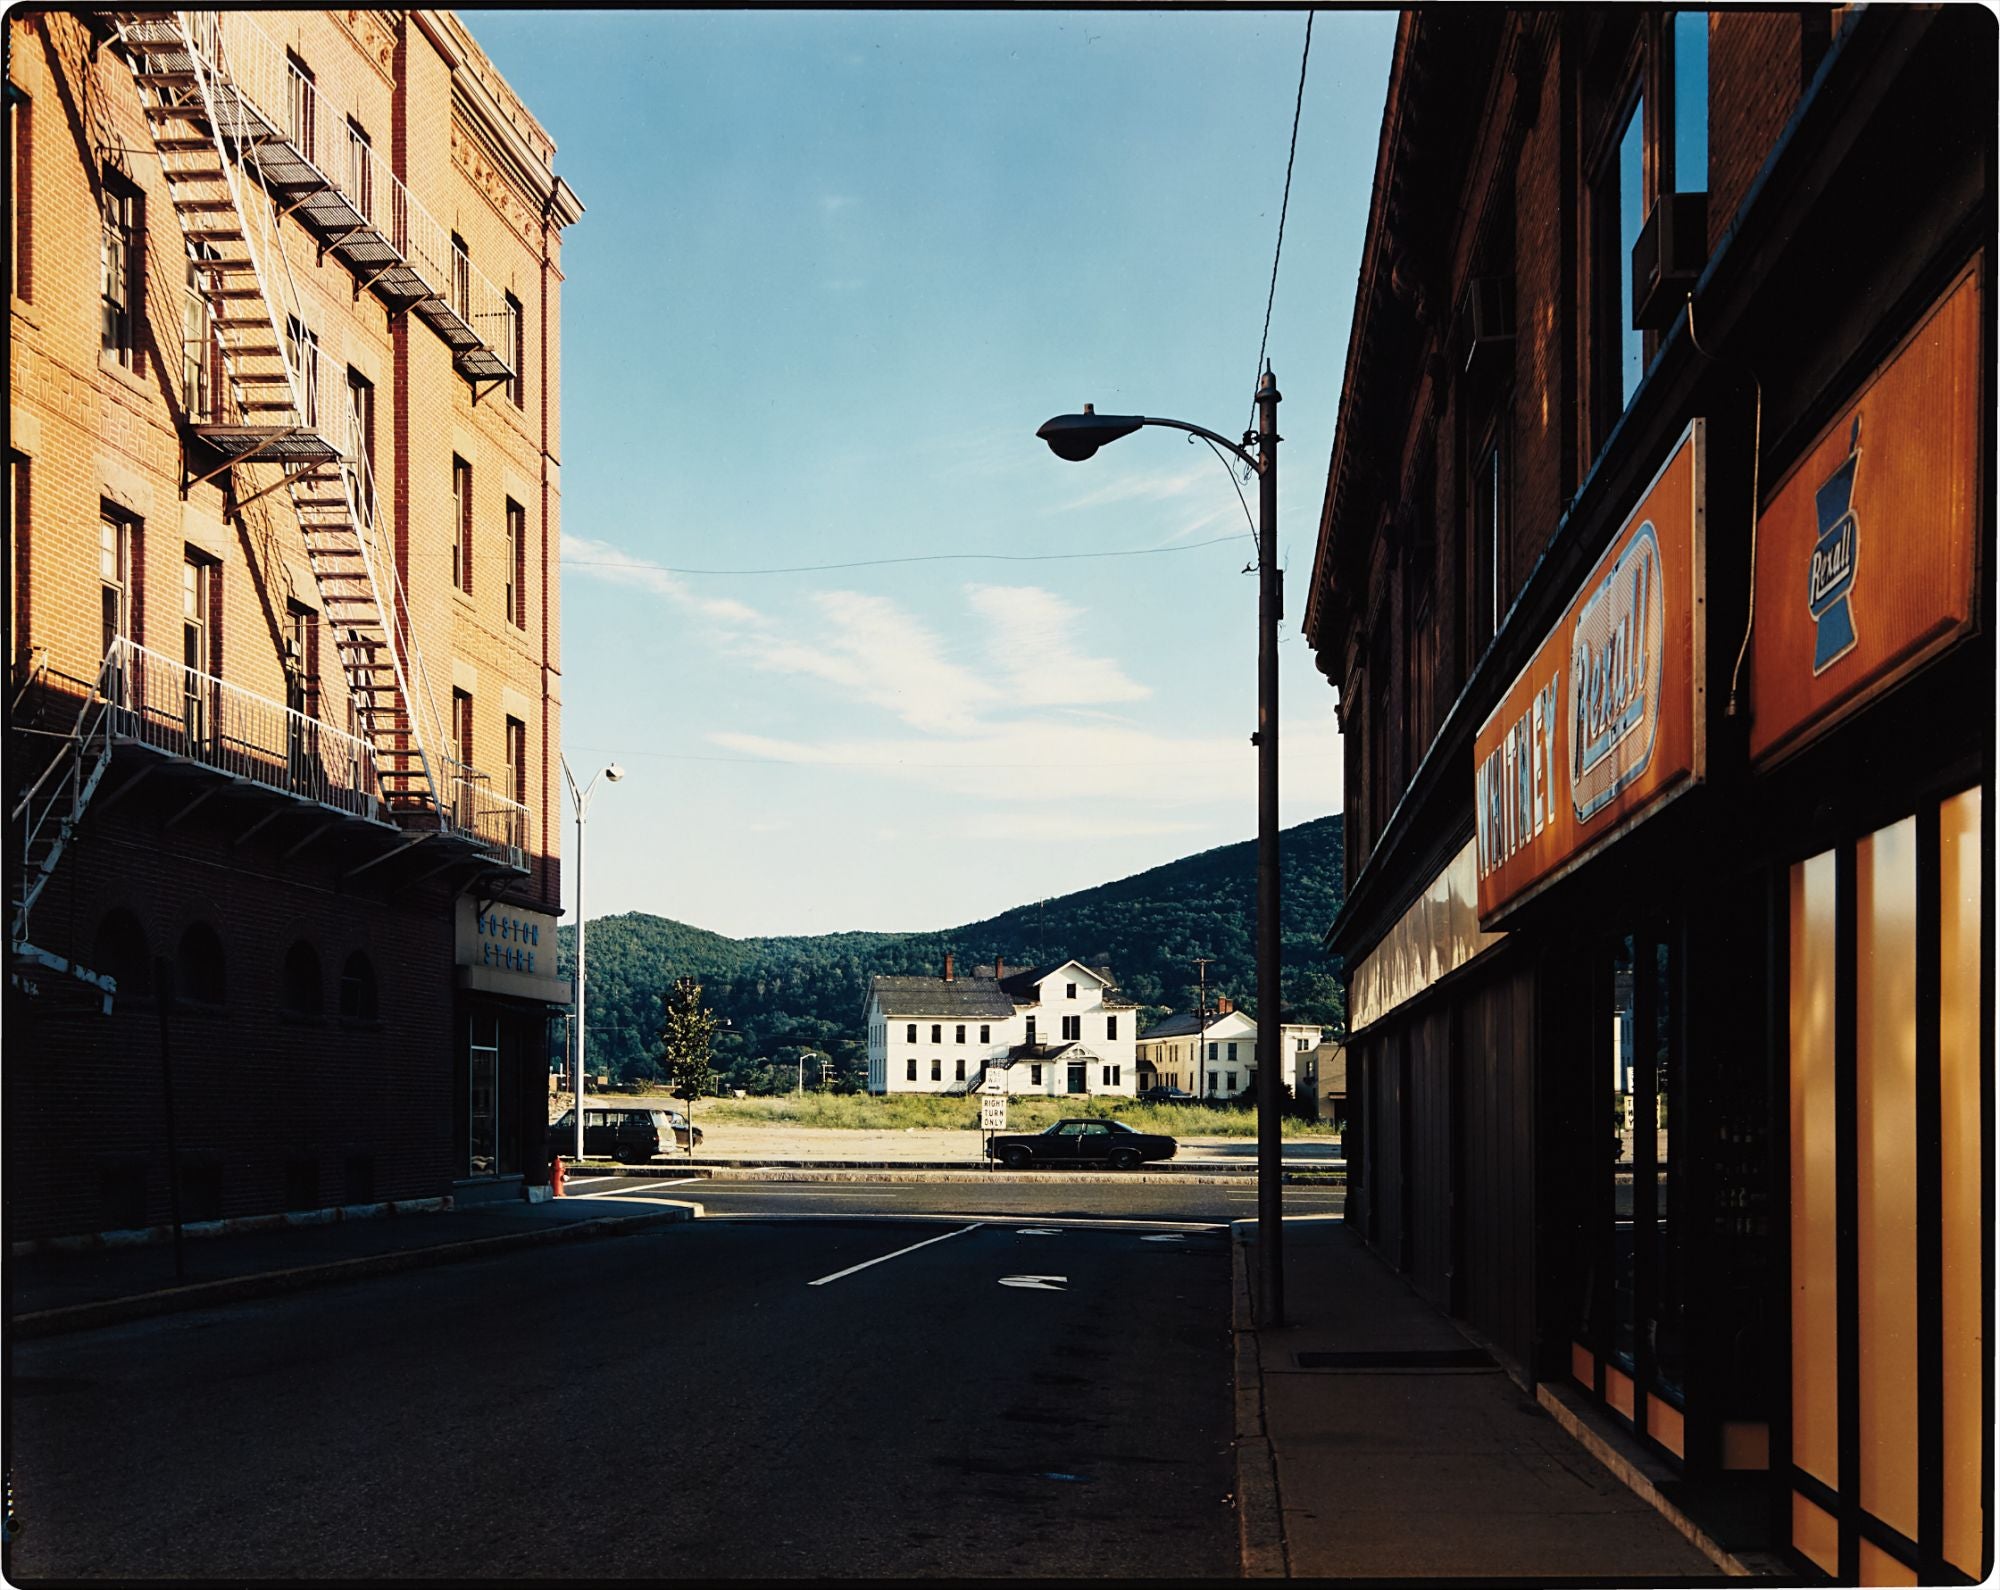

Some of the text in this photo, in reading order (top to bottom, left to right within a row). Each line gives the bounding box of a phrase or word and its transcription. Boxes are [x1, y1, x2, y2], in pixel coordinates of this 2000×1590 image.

[1809, 521, 1852, 607] Rexall
[1476, 552, 1649, 881] WHITNEY Rexall
[479, 911, 539, 946] BOSTON
[484, 941, 536, 974] STORE
[984, 1099, 1004, 1107] RIGHT
[984, 1109, 1004, 1117] TURN
[984, 1118, 1004, 1126] ONLY
